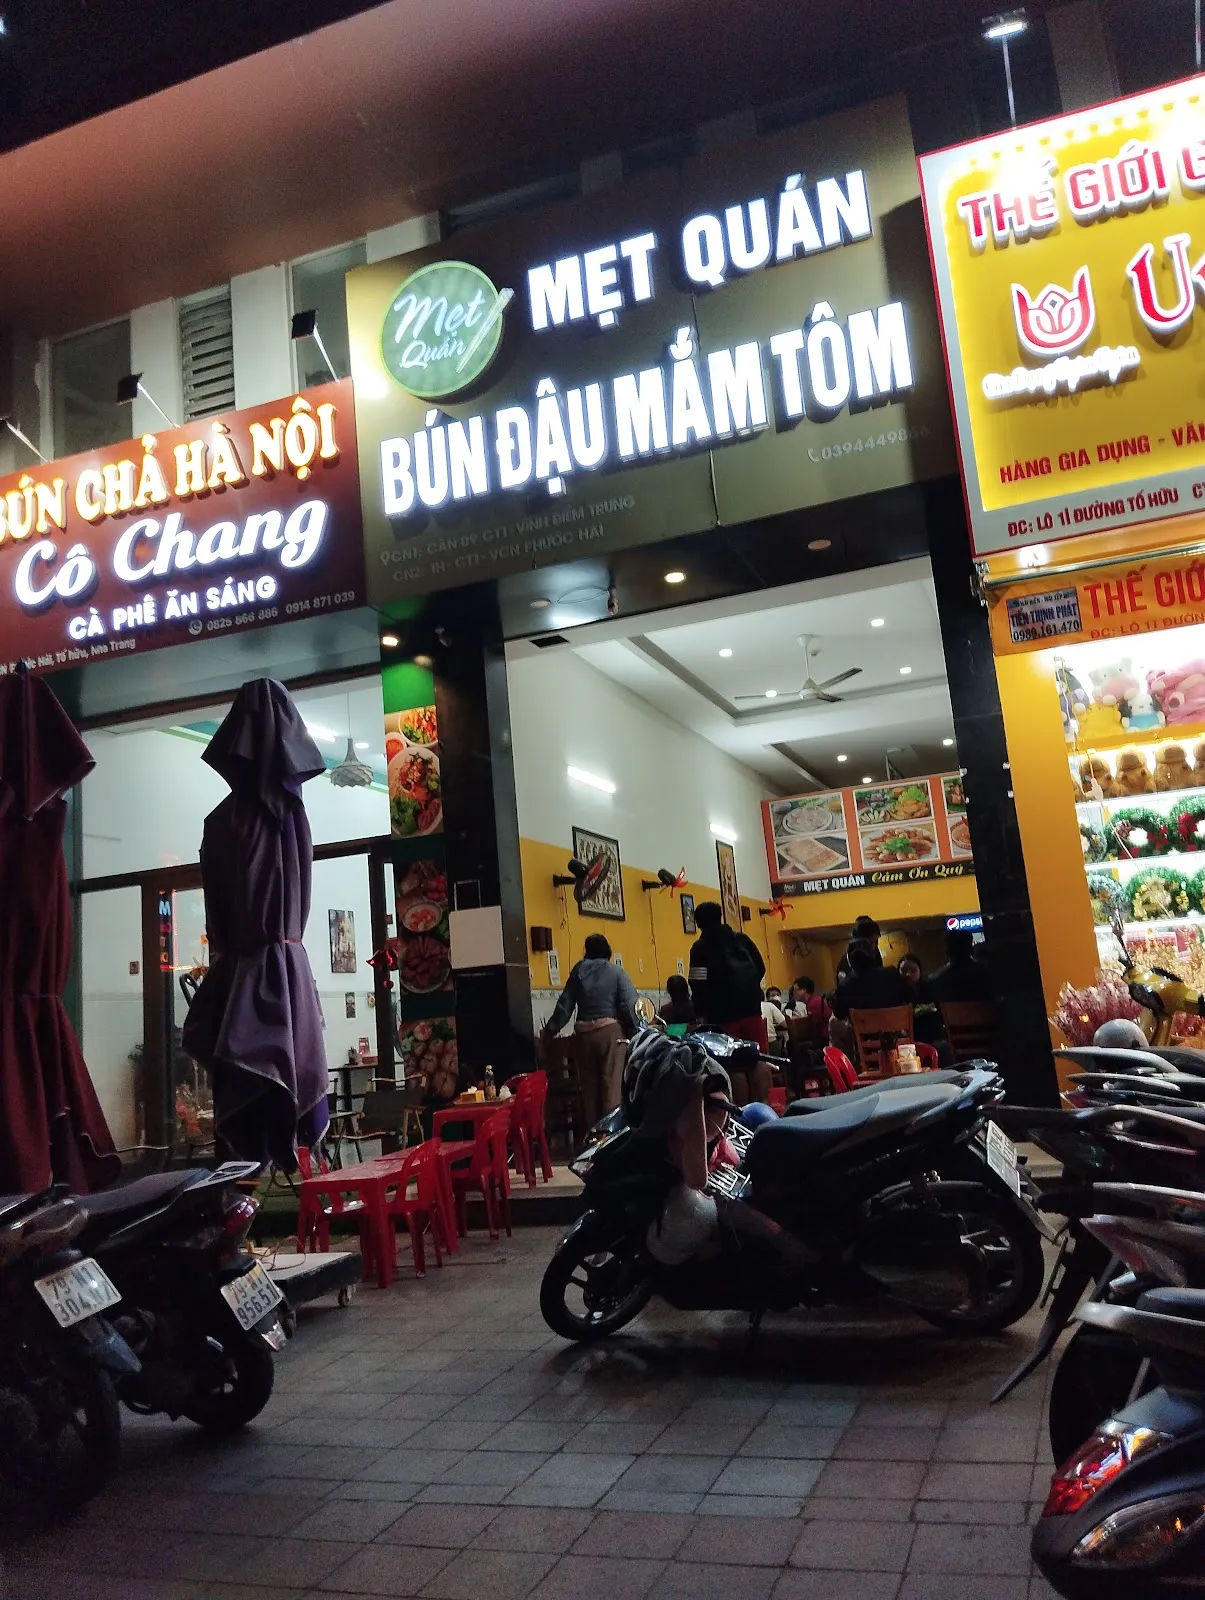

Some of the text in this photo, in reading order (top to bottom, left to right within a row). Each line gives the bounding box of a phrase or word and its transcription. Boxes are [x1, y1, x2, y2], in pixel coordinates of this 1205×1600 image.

[960, 160, 1056, 240] THẾ
[1067, 144, 1167, 211] GIỚI
[527, 169, 872, 331] MẸT QUÁN
[394, 289, 485, 344] Mẹt
[400, 336, 466, 368] Quán
[380, 409, 489, 517] BÚN
[496, 377, 605, 496] ĐẬU
[613, 326, 770, 461] MẮM
[770, 301, 914, 417] TÔM
[75, 434, 167, 521] CHẢ
[174, 420, 244, 496] HÀ
[249, 396, 338, 480] NỘI
[999, 457, 1051, 484] HÀNG
[1058, 448, 1091, 471] GIA
[1097, 435, 1151, 463] DỤNG
[1073, 500, 1125, 524] ĐƯỜNG
[1127, 489, 1146, 512] TỐ
[1148, 487, 1179, 508] HỮU
[15, 499, 329, 605] Cô Chang
[68, 576, 277, 639] CÀ PHÊ ĂN SÁNG
[1083, 564, 1147, 619] THẾ
[110, 639, 136, 651] Trang
[803, 879, 829, 893] MẸT
[831, 874, 866, 890] QUÁN
